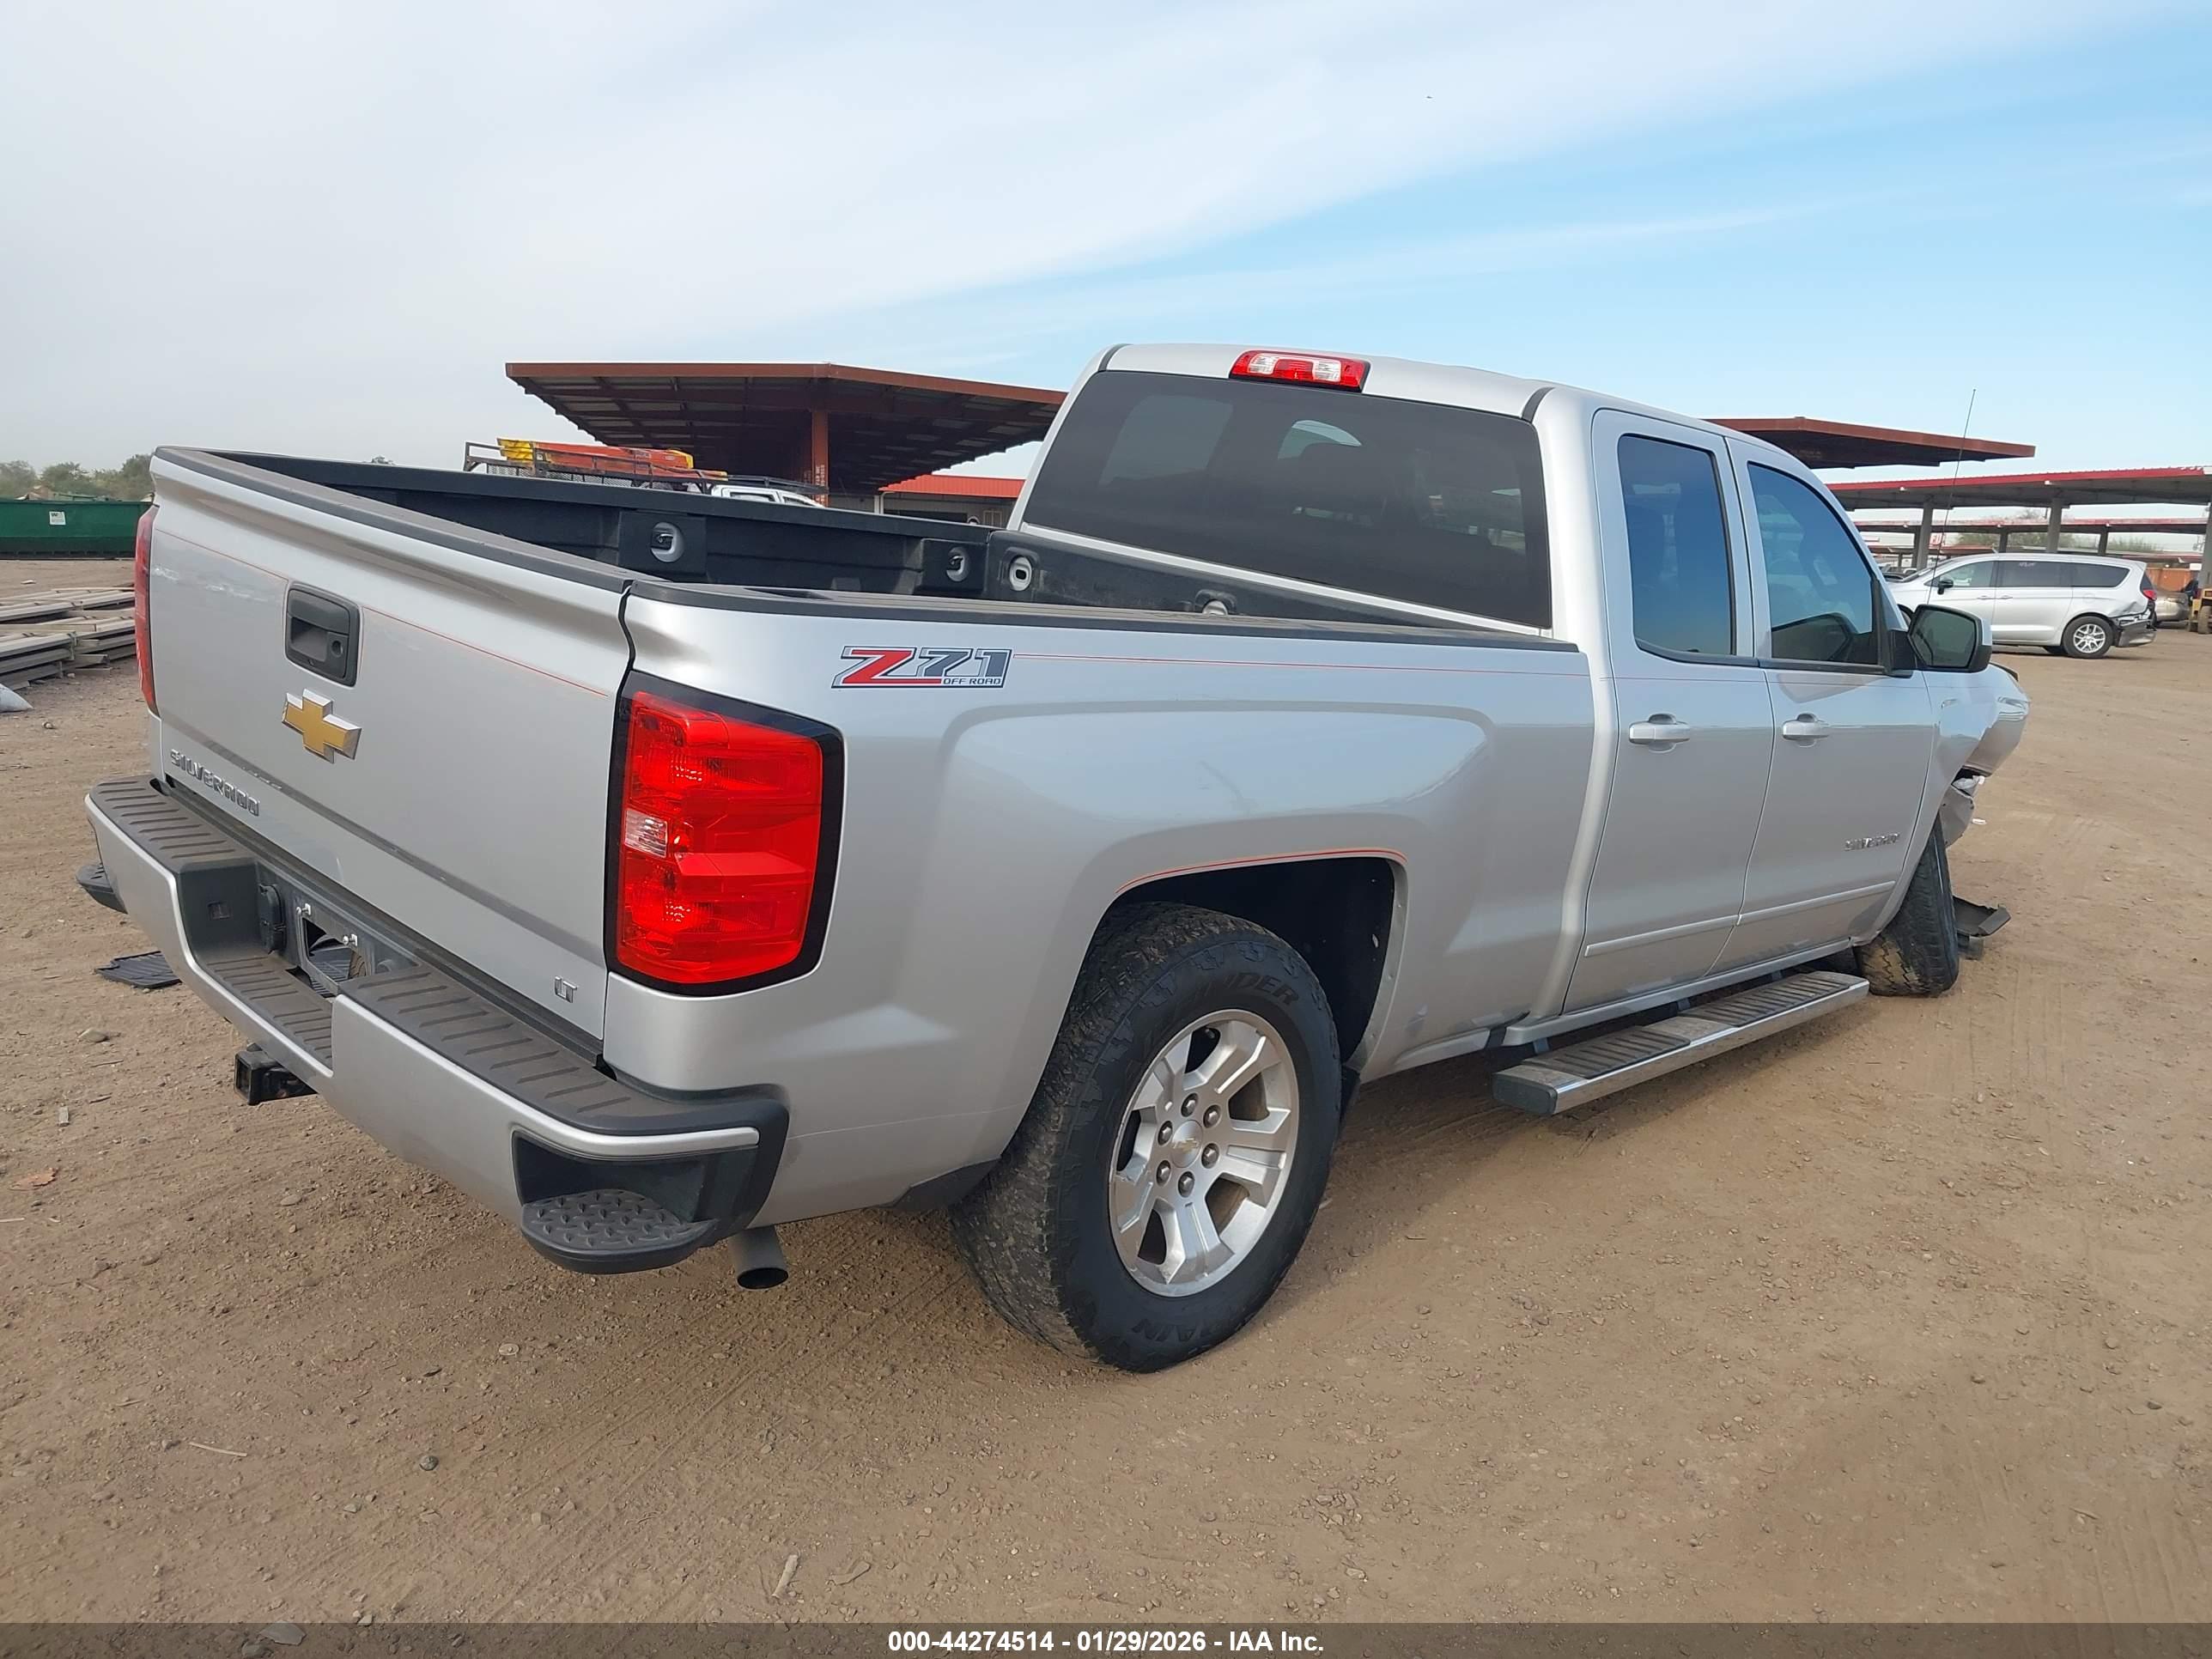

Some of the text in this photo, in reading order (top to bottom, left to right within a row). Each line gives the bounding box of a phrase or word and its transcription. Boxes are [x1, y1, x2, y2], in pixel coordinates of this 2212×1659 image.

[831, 646, 1012, 689] Z71
[171, 749, 260, 816] SILVERADO
[555, 976, 577, 1003] LT
